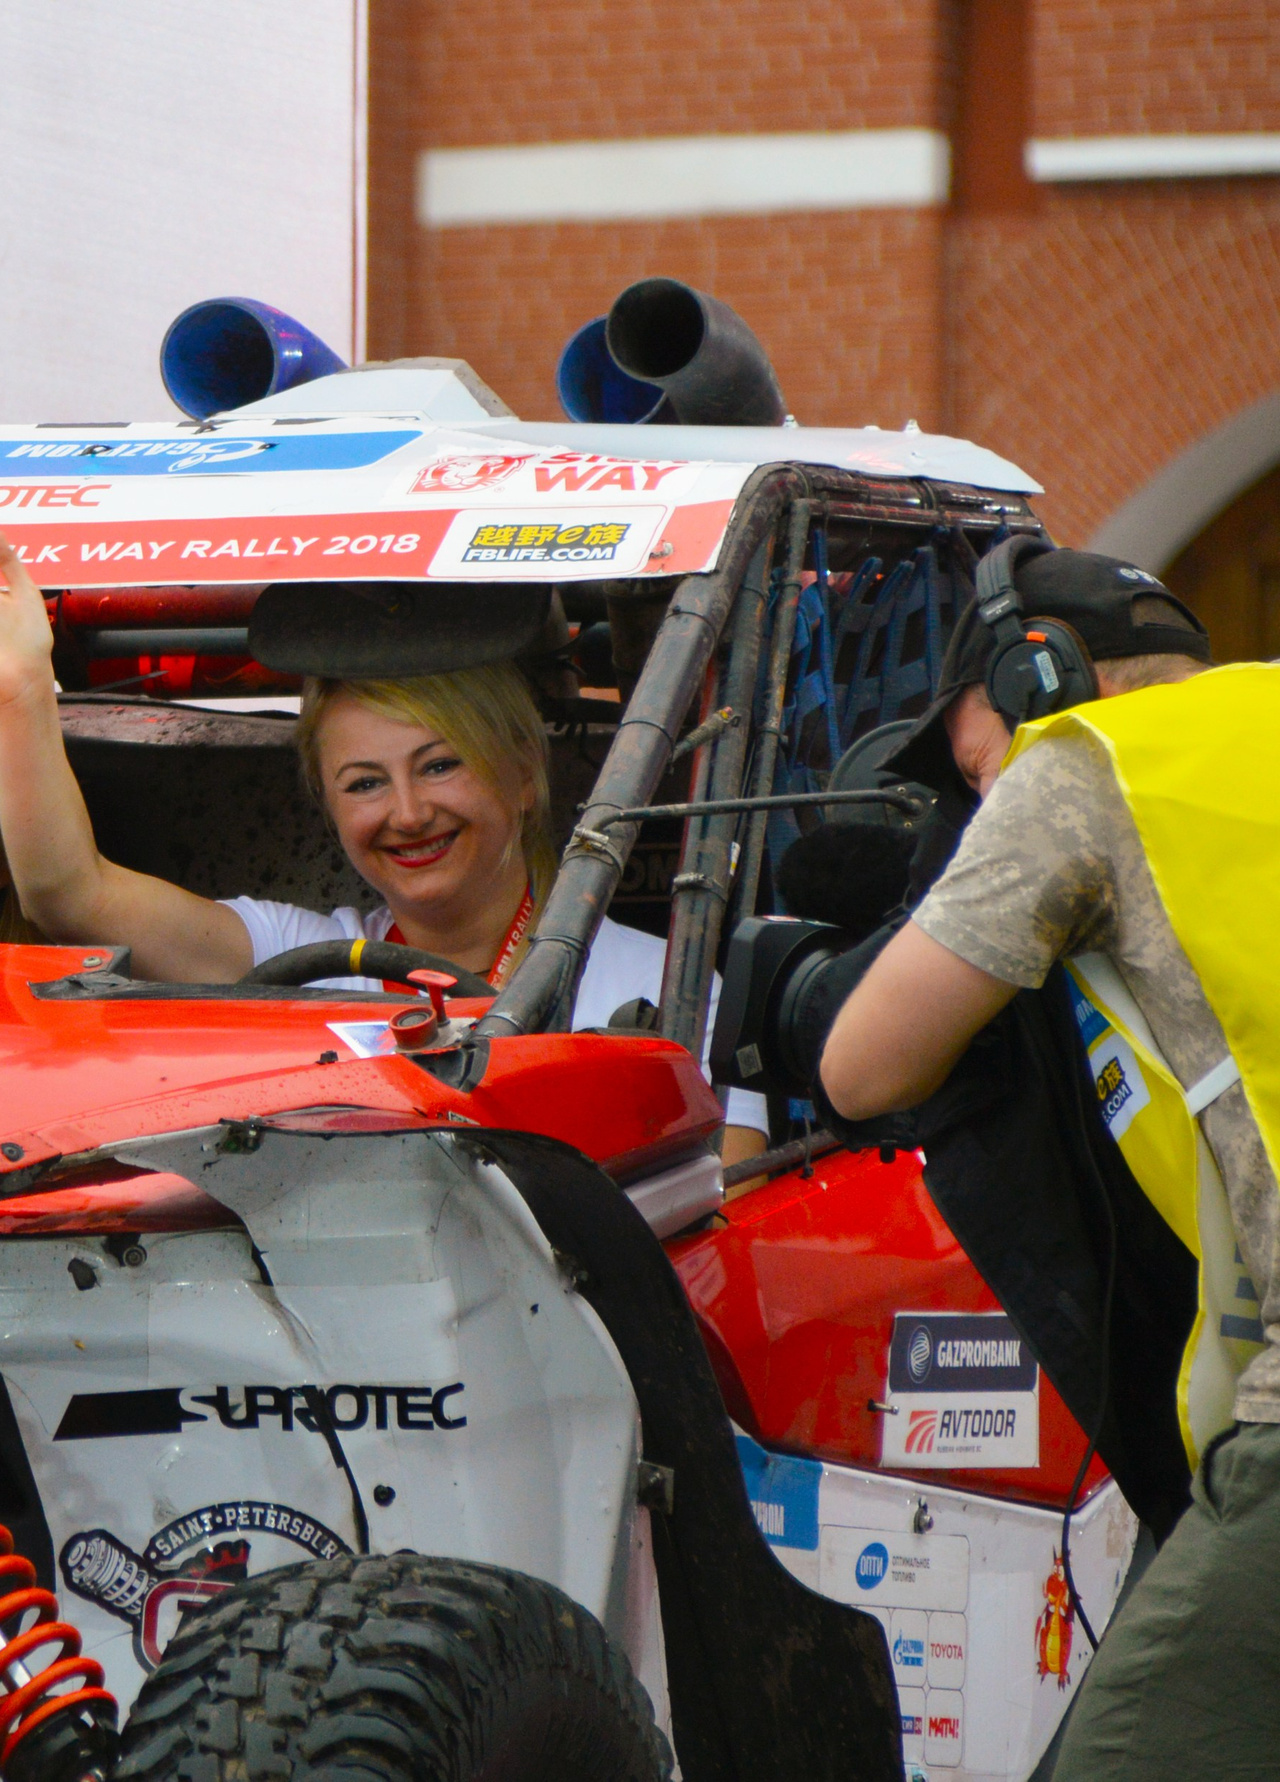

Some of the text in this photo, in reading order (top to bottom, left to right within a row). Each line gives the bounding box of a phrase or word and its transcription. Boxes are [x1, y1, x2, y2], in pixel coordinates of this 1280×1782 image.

[534, 465, 683, 492] WAY
[80, 541, 176, 562] WAY
[180, 536, 320, 559] RALLY
[322, 533, 421, 555] 2018
[472, 523, 629, 547] 越野e族
[465, 547, 615, 562] FBLIFE.COM
[937, 1340, 1021, 1368] GAZPROMBANK
[178, 1382, 468, 1433] SUPROTEC
[939, 1409, 1017, 1439] AVTODOR
[155, 1506, 341, 1561] SAINT PETERSBUR
[930, 1642, 963, 1660] TOYOTA
